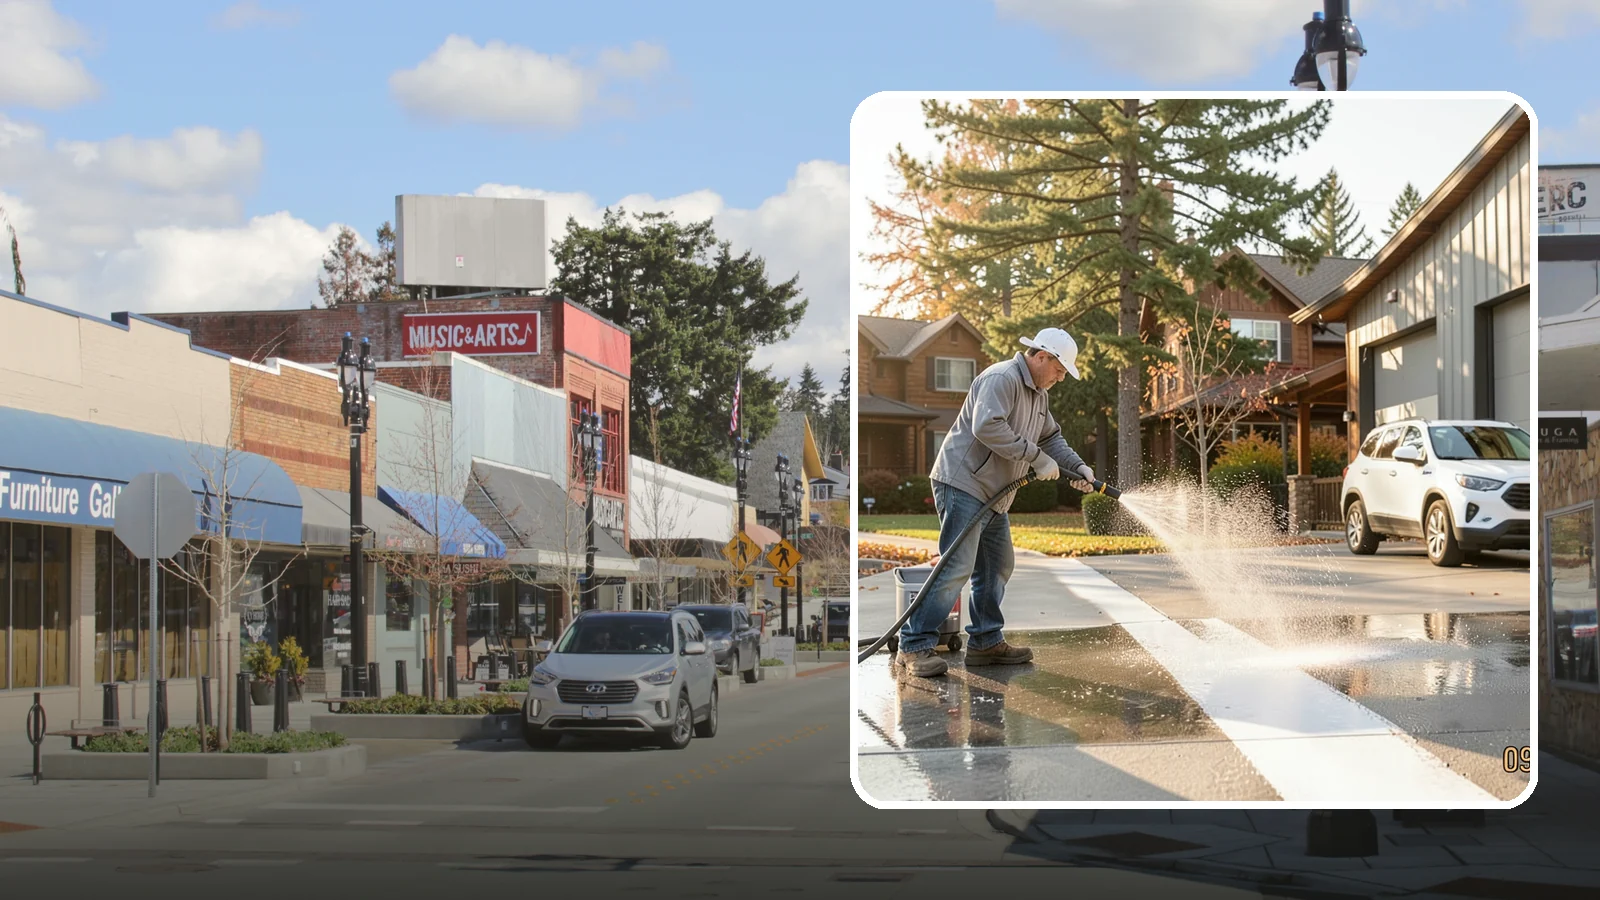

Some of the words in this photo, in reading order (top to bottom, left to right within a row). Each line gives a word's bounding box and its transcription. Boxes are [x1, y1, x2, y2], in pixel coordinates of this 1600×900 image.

[409, 323, 519, 348] MUSIC&ARTS
[0, 471, 79, 515] Furniture
[89, 482, 121, 519] Gal
[453, 563, 479, 574] SUSHI
